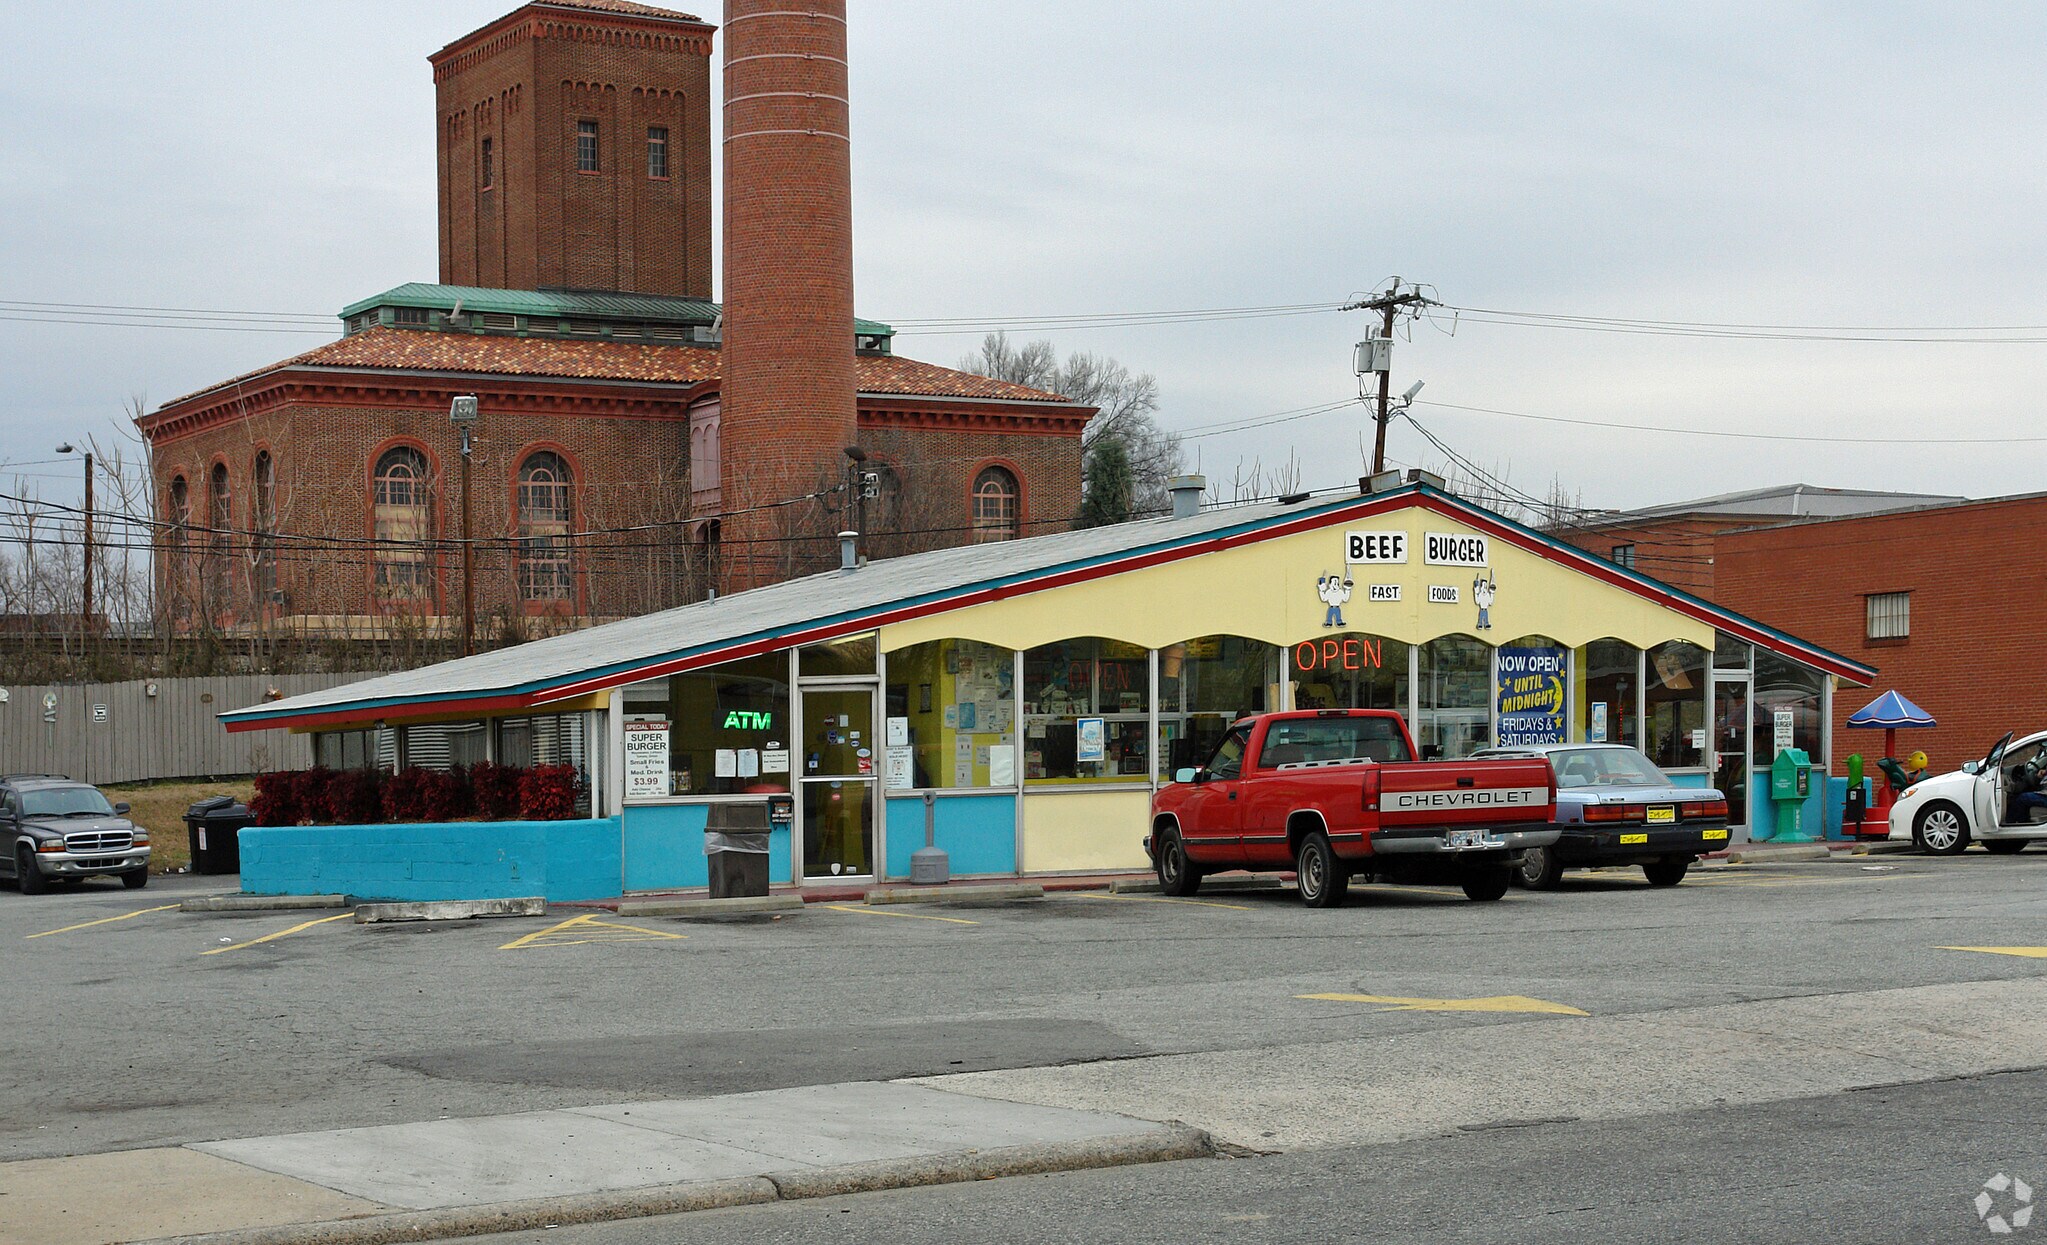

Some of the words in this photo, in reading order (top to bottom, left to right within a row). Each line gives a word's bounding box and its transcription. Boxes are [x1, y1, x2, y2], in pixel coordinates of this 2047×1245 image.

[1350, 535, 1403, 559] BEEF
[1428, 536, 1485, 562] BURGER
[1371, 586, 1399, 599] FAST
[1432, 587, 1457, 601] FOODS
[1296, 639, 1382, 671] OPEN
[1497, 656, 1526, 672] NOW
[1528, 656, 1559, 672] OPEN
[1513, 674, 1543, 693] UNTIL
[1502, 688, 1555, 714] MIDNIGHT
[723, 711, 772, 730] ATM
[1502, 718, 1544, 731] FRIDAYS
[1545, 718, 1553, 730] &
[1776, 713, 1791, 721] SUPER
[631, 733, 663, 742] SUPER
[1500, 733, 1557, 747] SATURDAYS
[627, 742, 667, 751] BURGER
[634, 777, 659, 786] $3.99
[1399, 791, 1532, 807] CHEVROLET
